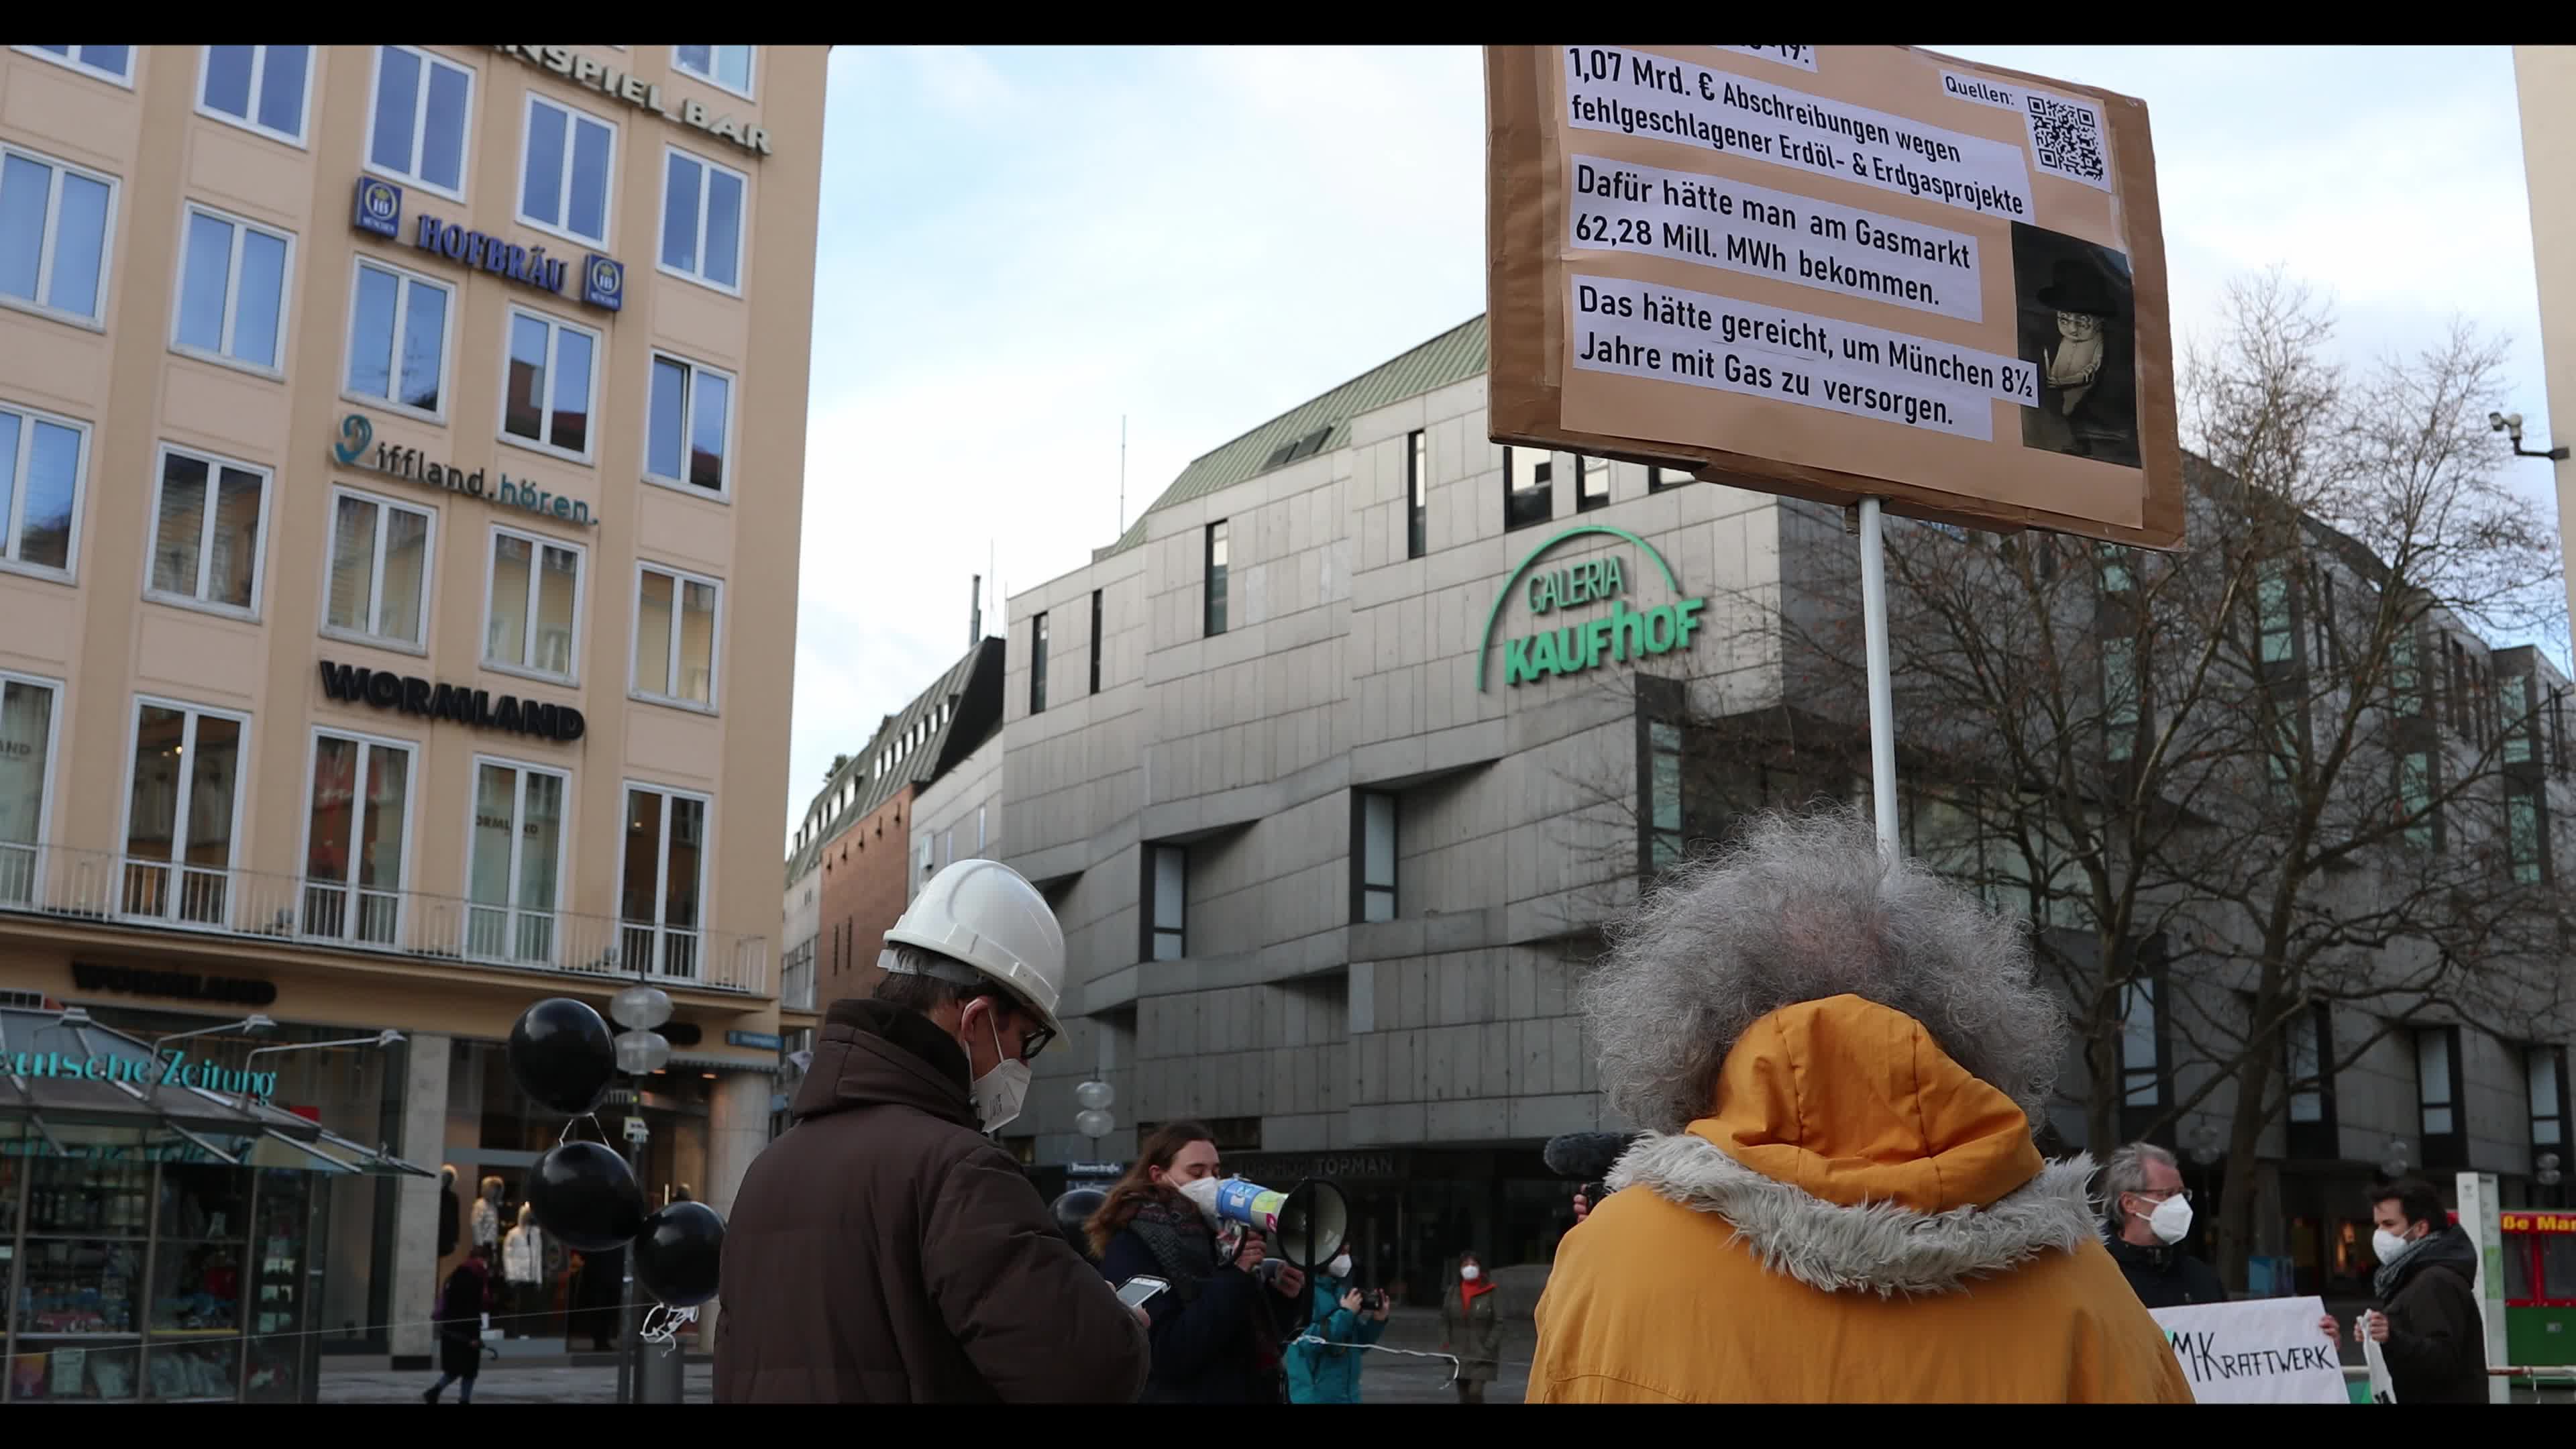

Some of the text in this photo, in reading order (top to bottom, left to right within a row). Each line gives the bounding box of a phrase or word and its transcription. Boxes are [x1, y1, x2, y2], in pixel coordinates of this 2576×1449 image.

[682, 98, 771, 155] BAR
[1569, 48, 1961, 163] 1,07 Mrd. € Abschreibungen wegen
[1945, 76, 2015, 105] Quellen:
[1572, 94, 2023, 215] fehlgeschlagener Erdöl- & Erdgasprojekte
[417, 214, 568, 294] HOFBRÄU
[1578, 164, 1970, 269] Dafür hätte man am Gasmarkt
[1576, 213, 1939, 305] 62,28 Mill. MWh bekommen.
[1579, 285, 1633, 317] Das
[1643, 292, 1712, 331] hätte
[1722, 314, 1833, 360] gereicht,
[1843, 337, 1880, 364] um
[1888, 340, 1993, 389] München
[1580, 331, 1953, 425] Jahre mit Gas zu versorgen.
[1525, 555, 1626, 614] GALERIA
[319, 660, 585, 741] WORMLAND
[158, 1049, 275, 1106] Zeitung
[1316, 1155, 1394, 1177] TOPMAN
